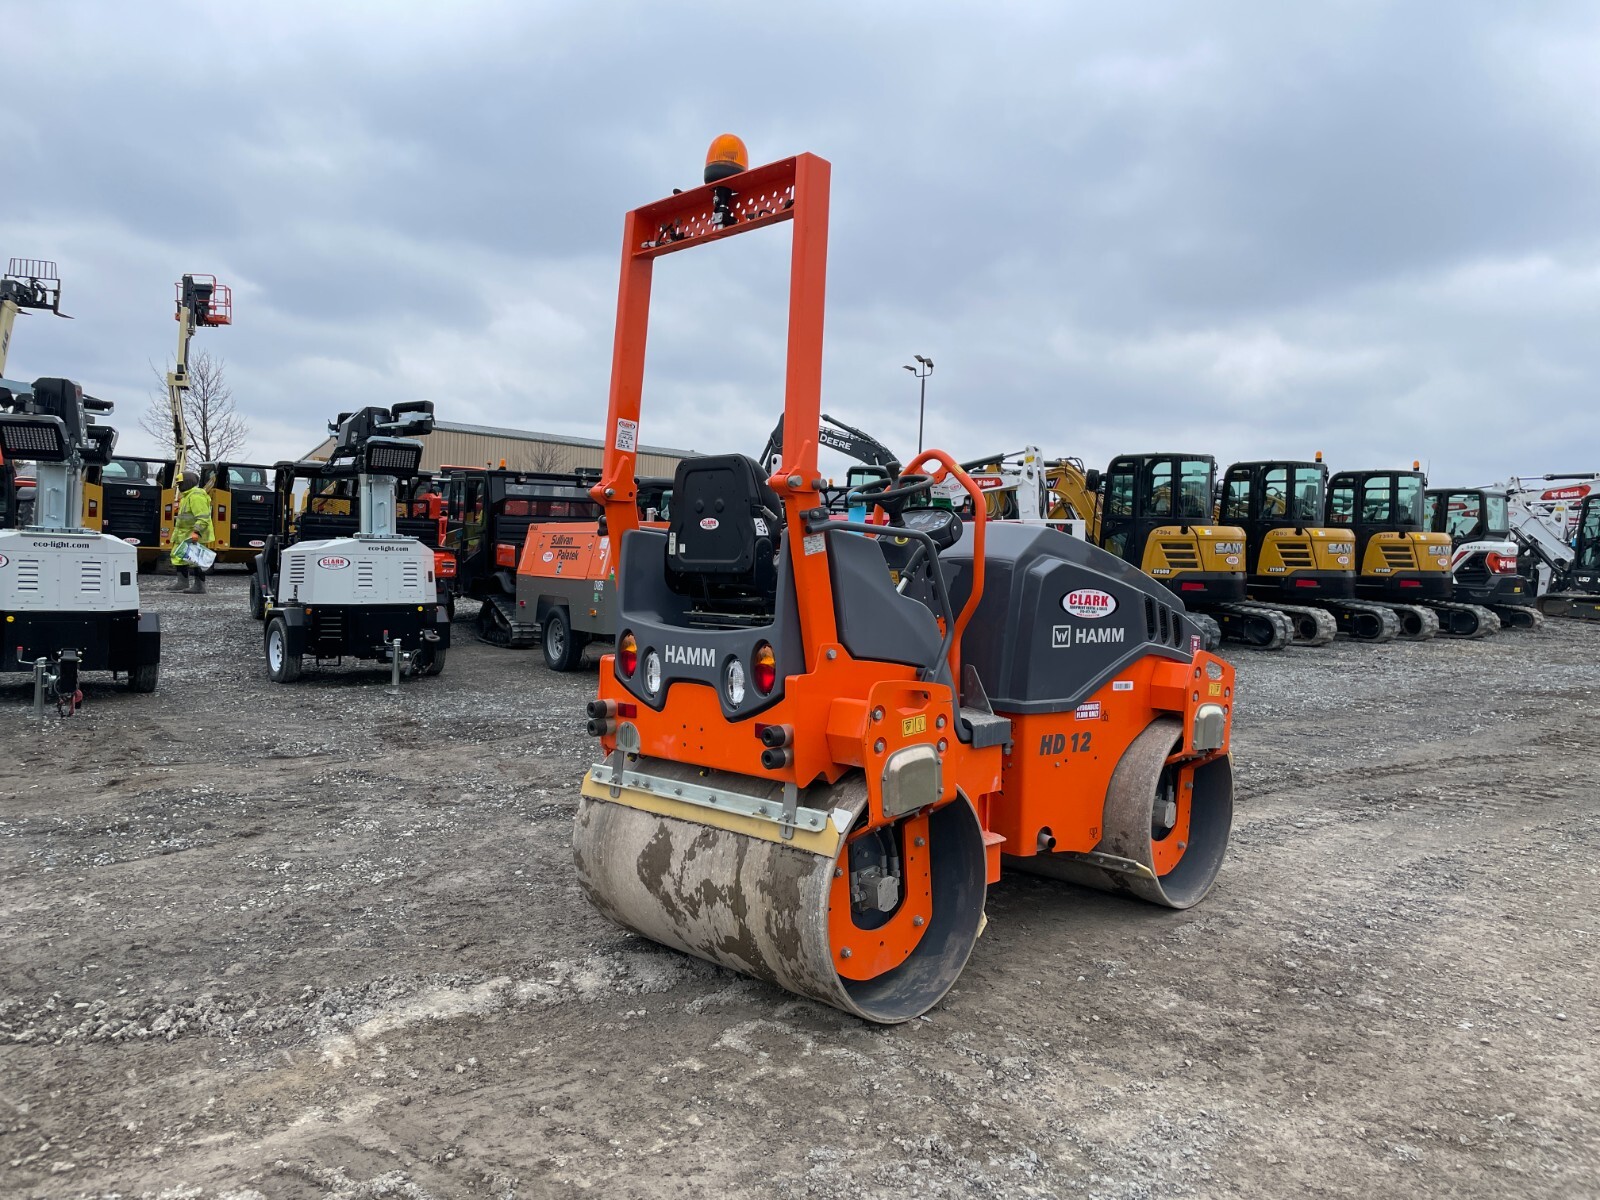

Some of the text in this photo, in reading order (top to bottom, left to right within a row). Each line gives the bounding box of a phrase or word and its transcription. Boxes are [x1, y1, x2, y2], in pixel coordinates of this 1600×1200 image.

[820, 433, 852, 450] DEERE
[33, 541, 90, 549] eco-light.com
[551, 534, 574, 545] Sullivan
[1215, 542, 1243, 554] SANY
[1069, 593, 1109, 607] CLARK
[1075, 627, 1125, 643] HAMM
[665, 644, 716, 668] HAMM
[1039, 731, 1092, 756] HD 12
